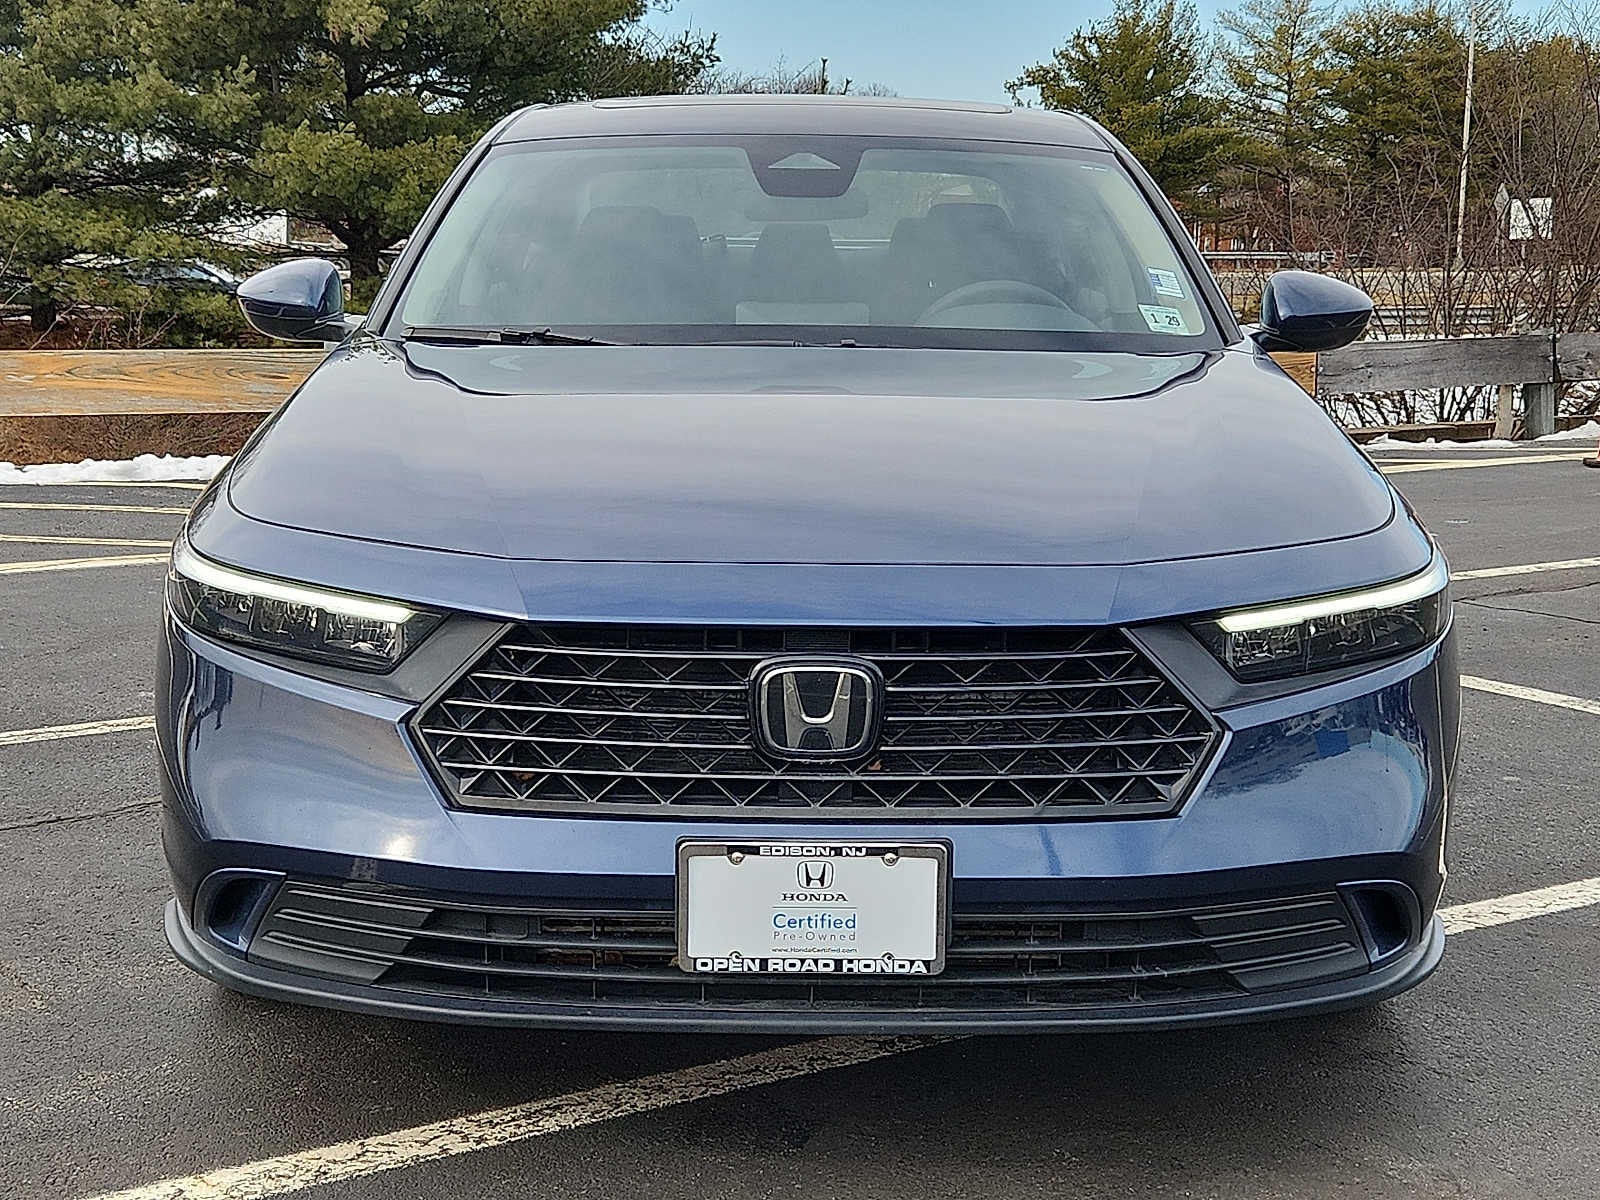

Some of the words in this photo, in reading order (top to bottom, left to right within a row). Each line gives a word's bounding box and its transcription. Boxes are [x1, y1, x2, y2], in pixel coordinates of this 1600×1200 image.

[1150, 313, 1160, 323] 1
[1165, 315, 1180, 326] 29
[759, 846, 836, 857] EDISON,
[842, 847, 867, 857] NJ
[781, 893, 849, 902] HONDA
[773, 913, 856, 929] Certified
[773, 931, 856, 941] Pre-Owned
[695, 958, 761, 972] OPEN
[767, 959, 836, 973] ROAD
[842, 959, 928, 974] HONDA
